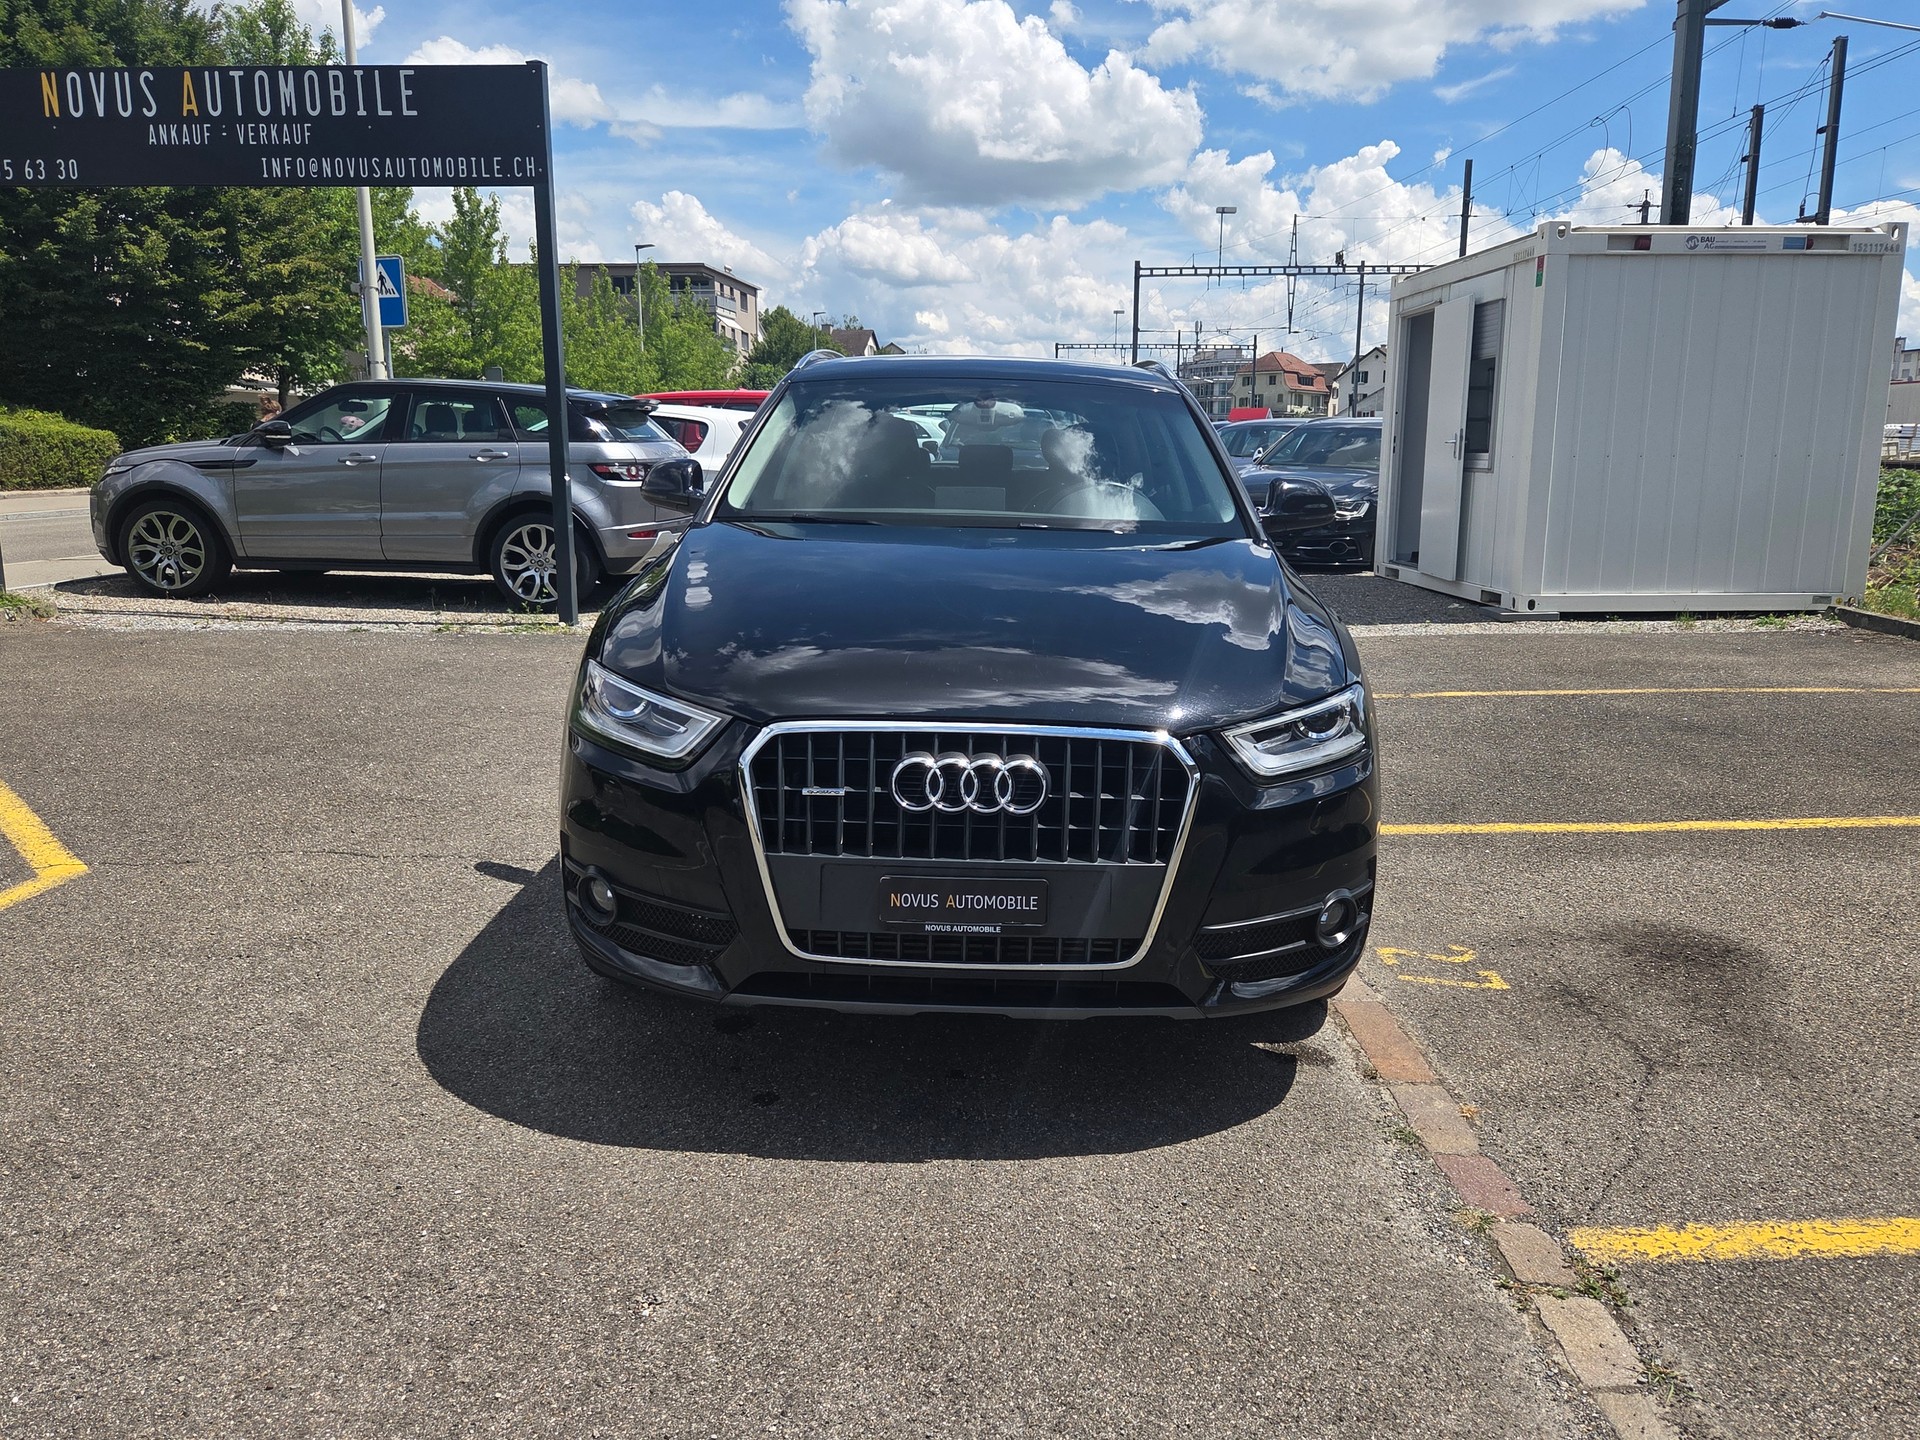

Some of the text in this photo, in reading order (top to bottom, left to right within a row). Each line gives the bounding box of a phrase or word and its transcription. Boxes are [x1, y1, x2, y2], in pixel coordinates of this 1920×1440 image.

[40, 69, 418, 118] NOVUS AUTOMOBILE
[149, 124, 211, 145] ANKAUF
[236, 123, 312, 145] VERKAUF
[3, 159, 78, 180] 5 63 30
[261, 157, 536, 178] INFO@NOVUSAUTOMOBILE.CH
[890, 893, 1038, 910] NOVUS AUTOMOBILE
[925, 924, 1001, 933] NOVUS AUTOMOBILE
